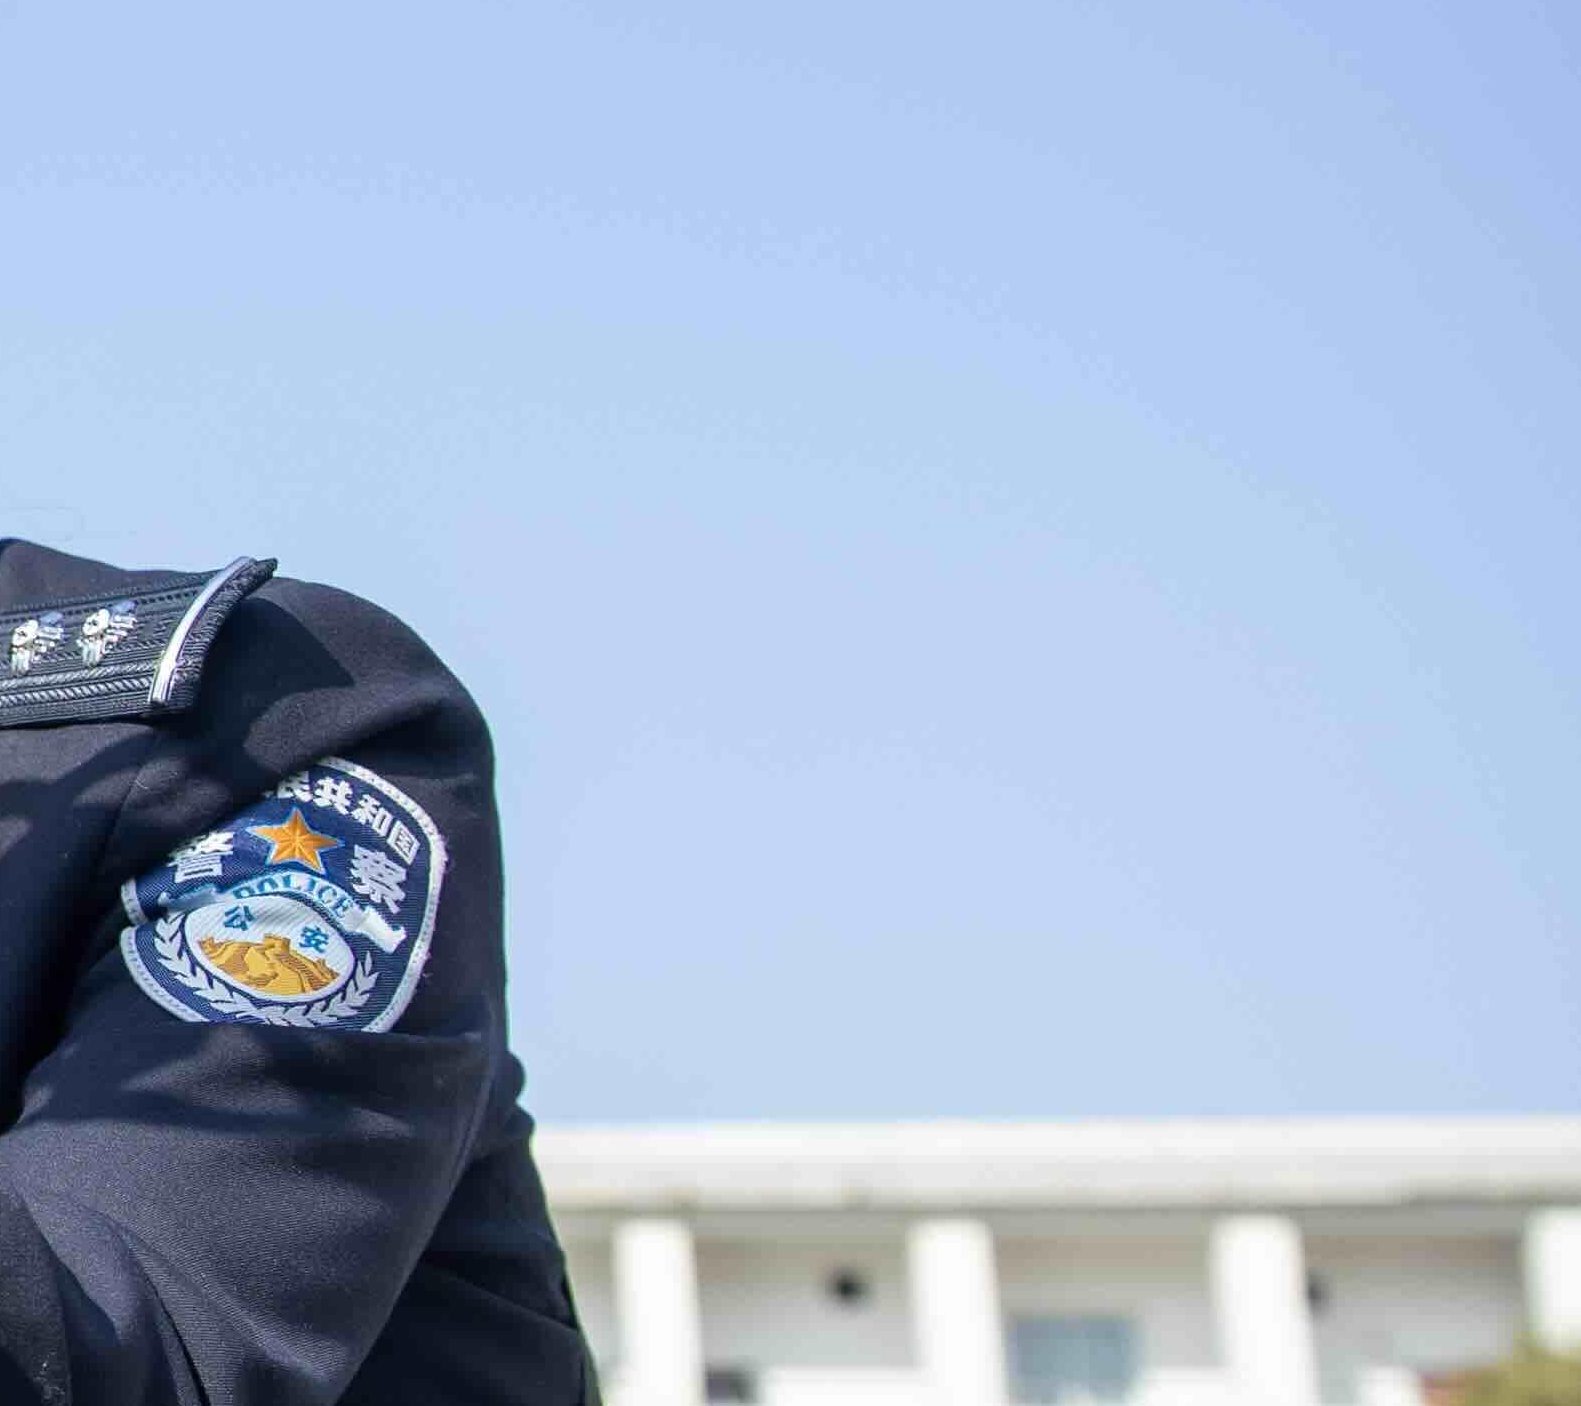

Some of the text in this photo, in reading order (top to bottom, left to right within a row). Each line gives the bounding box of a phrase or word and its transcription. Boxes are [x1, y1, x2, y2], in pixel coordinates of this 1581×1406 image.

[263, 771, 421, 865] 民共和国
[232, 872, 354, 919] POLICE
